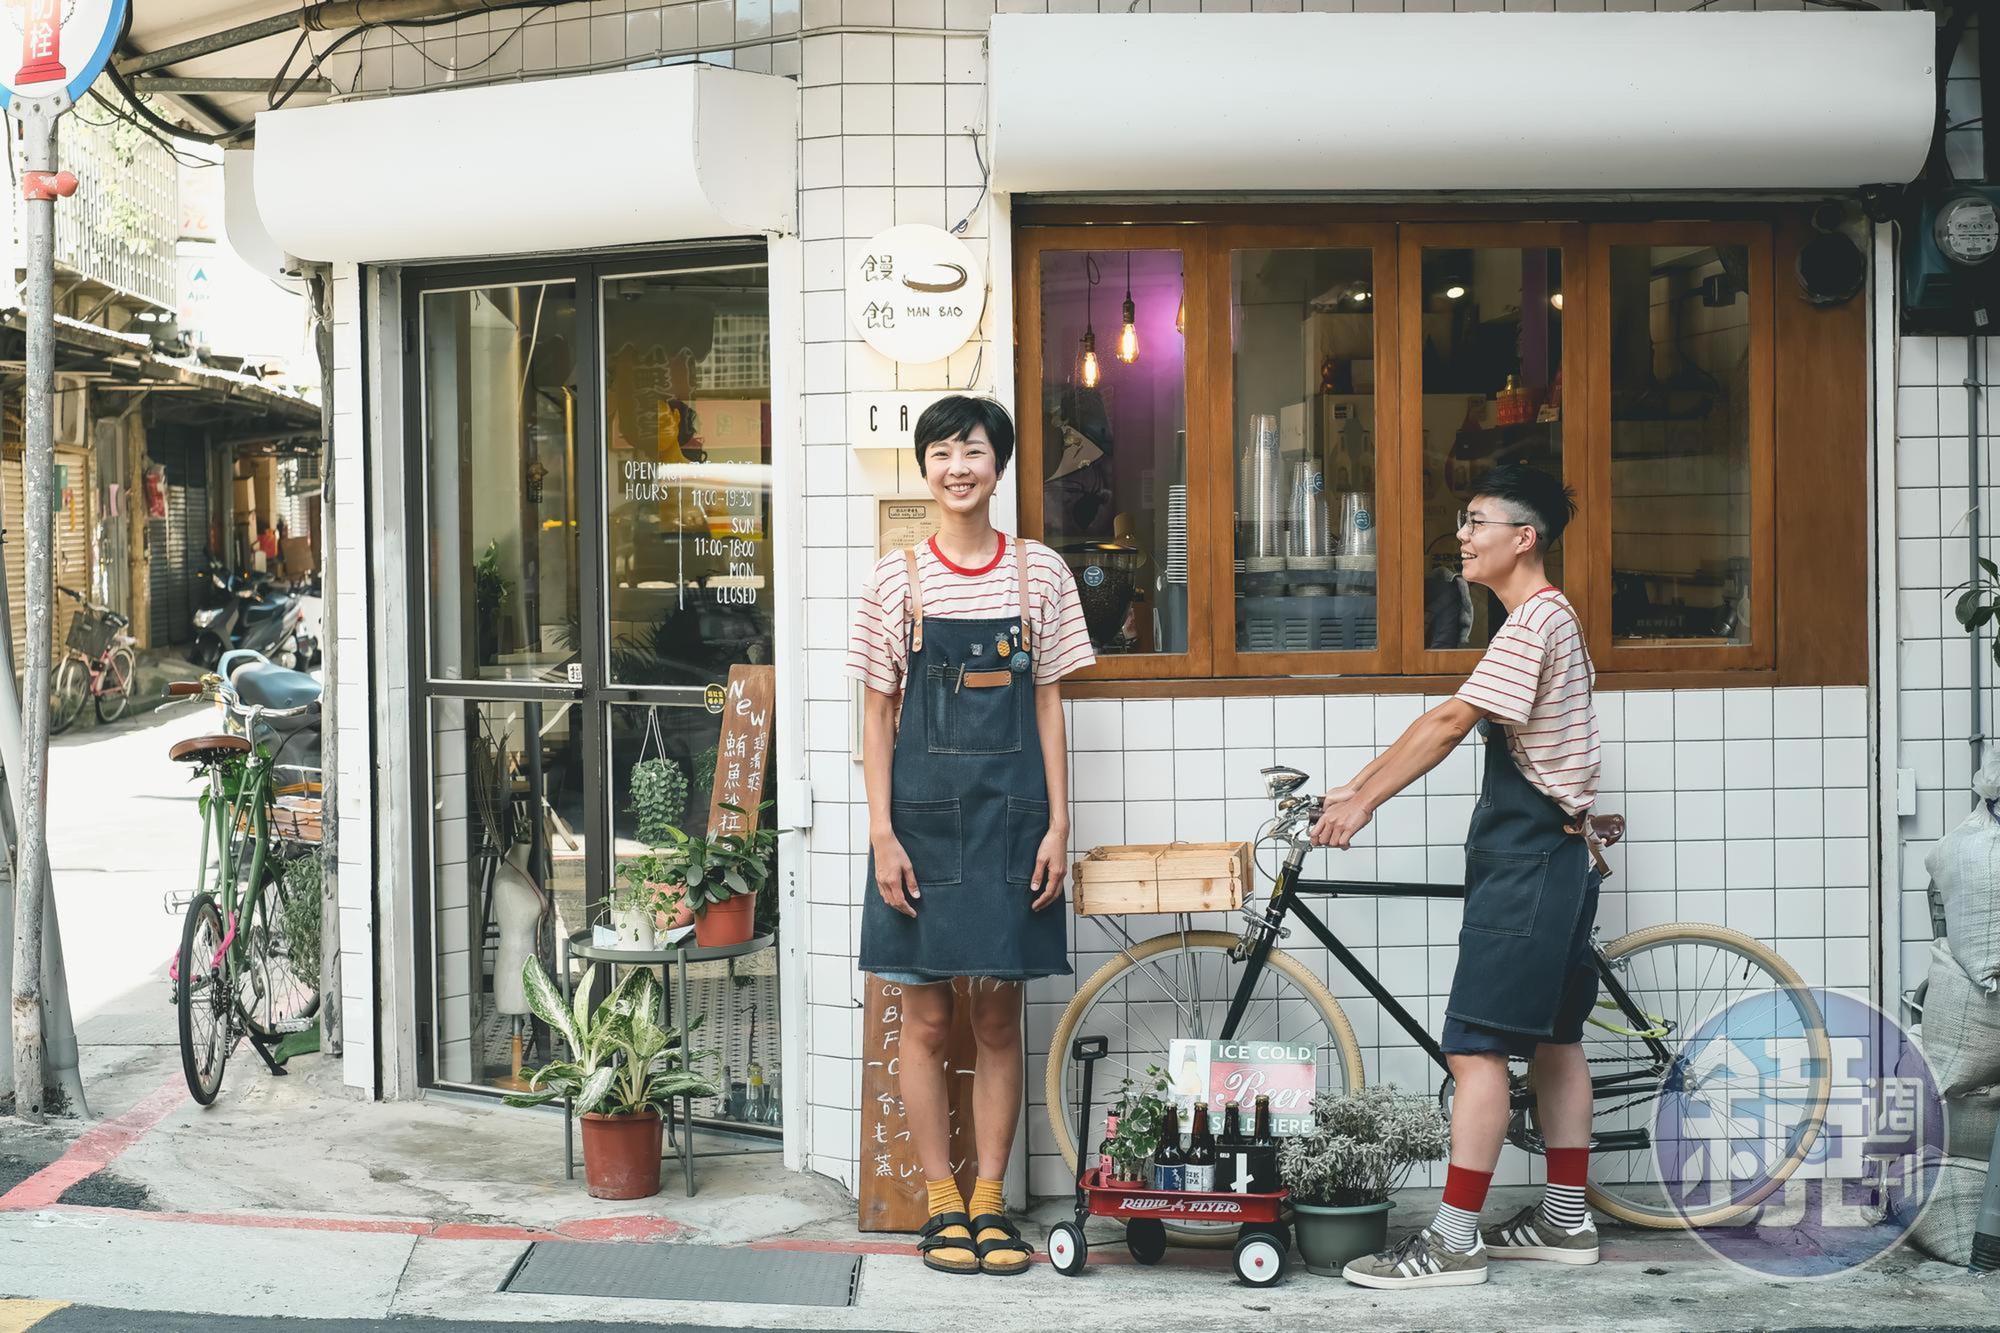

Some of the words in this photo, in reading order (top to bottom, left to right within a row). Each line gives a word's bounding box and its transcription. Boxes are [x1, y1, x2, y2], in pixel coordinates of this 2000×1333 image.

[906, 306, 930, 317] MAN
[938, 306, 963, 317] BAO
[869, 404, 908, 432] CA
[625, 482, 668, 501] HOURS
[691, 489, 753, 507] 11:00-19:30
[731, 517, 754, 534] SUN
[694, 537, 754, 557] 11:00-18:00
[729, 562, 754, 580] MON
[716, 586, 757, 604] CLOSED
[729, 680, 766, 727] New
[1219, 1045, 1250, 1059] ICE
[1258, 1046, 1311, 1060] COLD
[1215, 1067, 1312, 1109] Beer
[1212, 1116, 1255, 1133] SD
[1118, 1198, 1172, 1211] RADIO
[1188, 1201, 1242, 1213] FLYER
